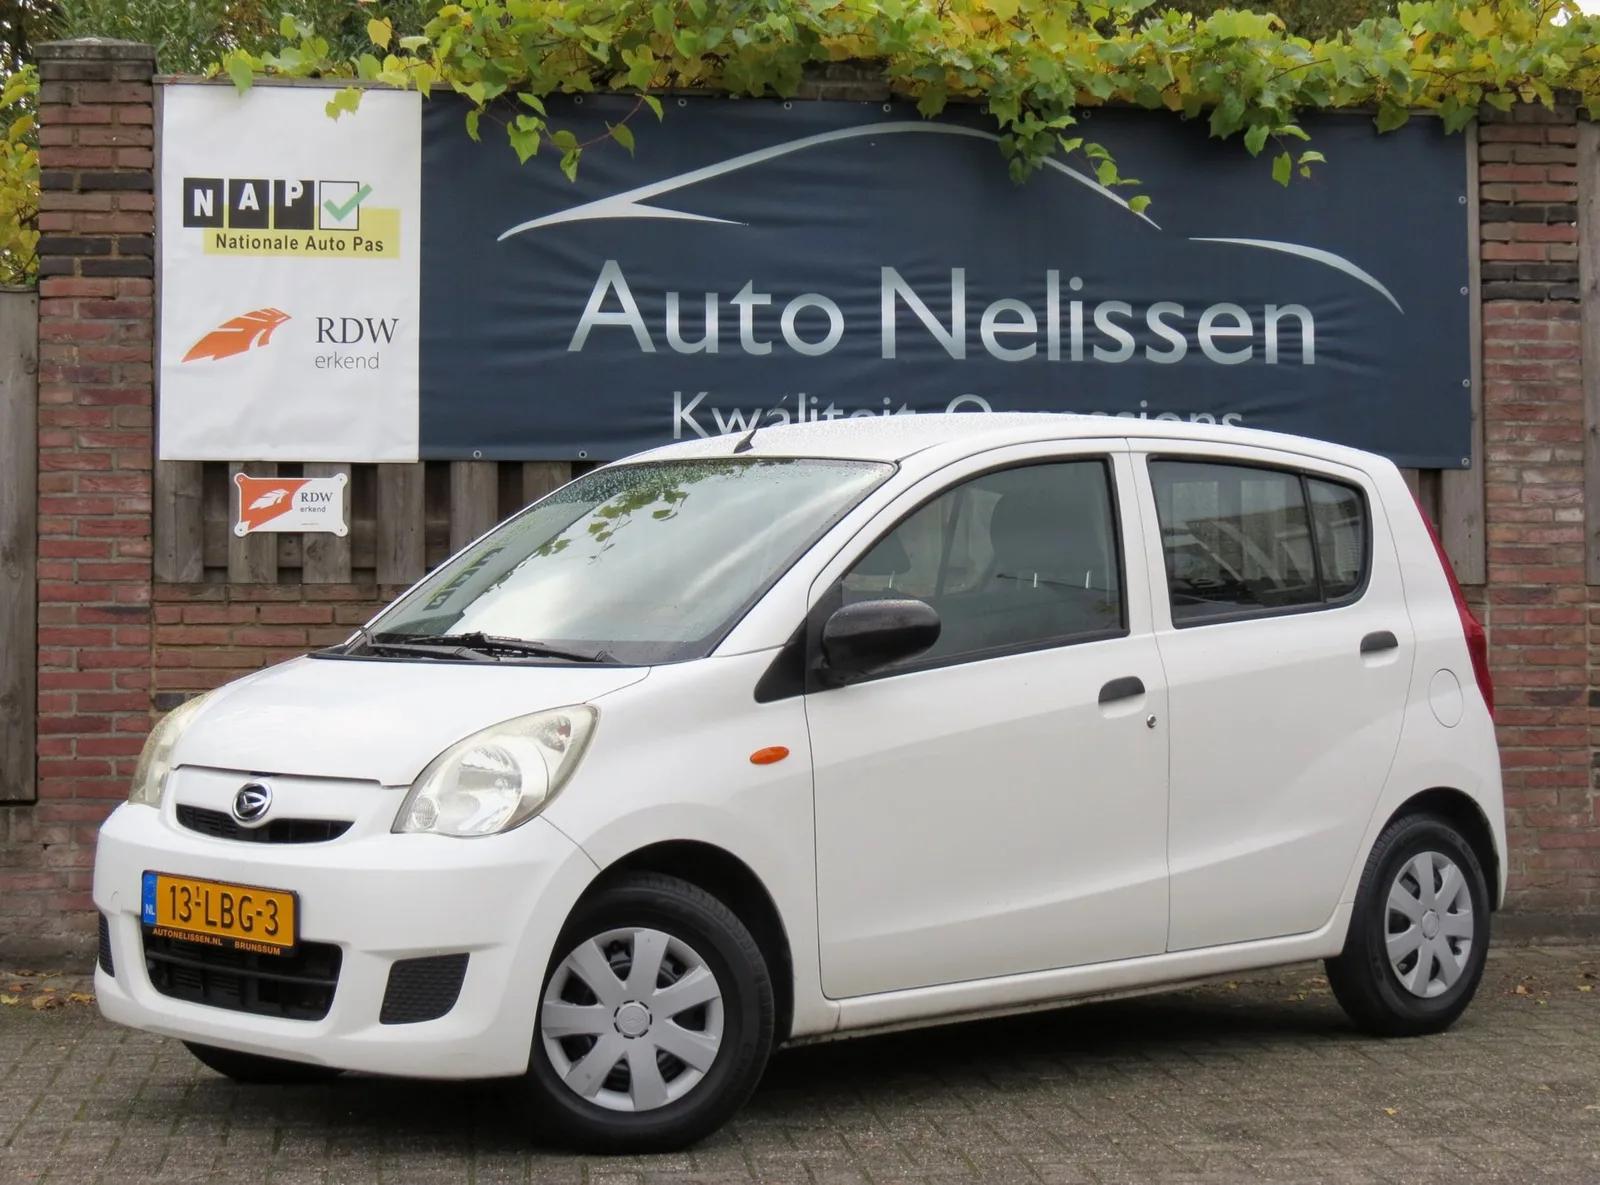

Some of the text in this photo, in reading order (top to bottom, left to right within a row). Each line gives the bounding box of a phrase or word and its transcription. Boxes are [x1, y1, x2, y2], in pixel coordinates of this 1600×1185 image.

[193, 180, 304, 217] NAP
[216, 233, 384, 252] Nationale Auto Pas
[567, 259, 1316, 364] Auto Nelissen
[315, 316, 400, 344] RDW
[315, 351, 380, 369] erkend
[672, 390, 917, 440] Kwali
[300, 492, 333, 503] RDW
[145, 903, 156, 916] NL
[169, 885, 279, 937] 13-LBG-3
[152, 928, 281, 956] AUTONELISSEN.NL BRUNSSUM
